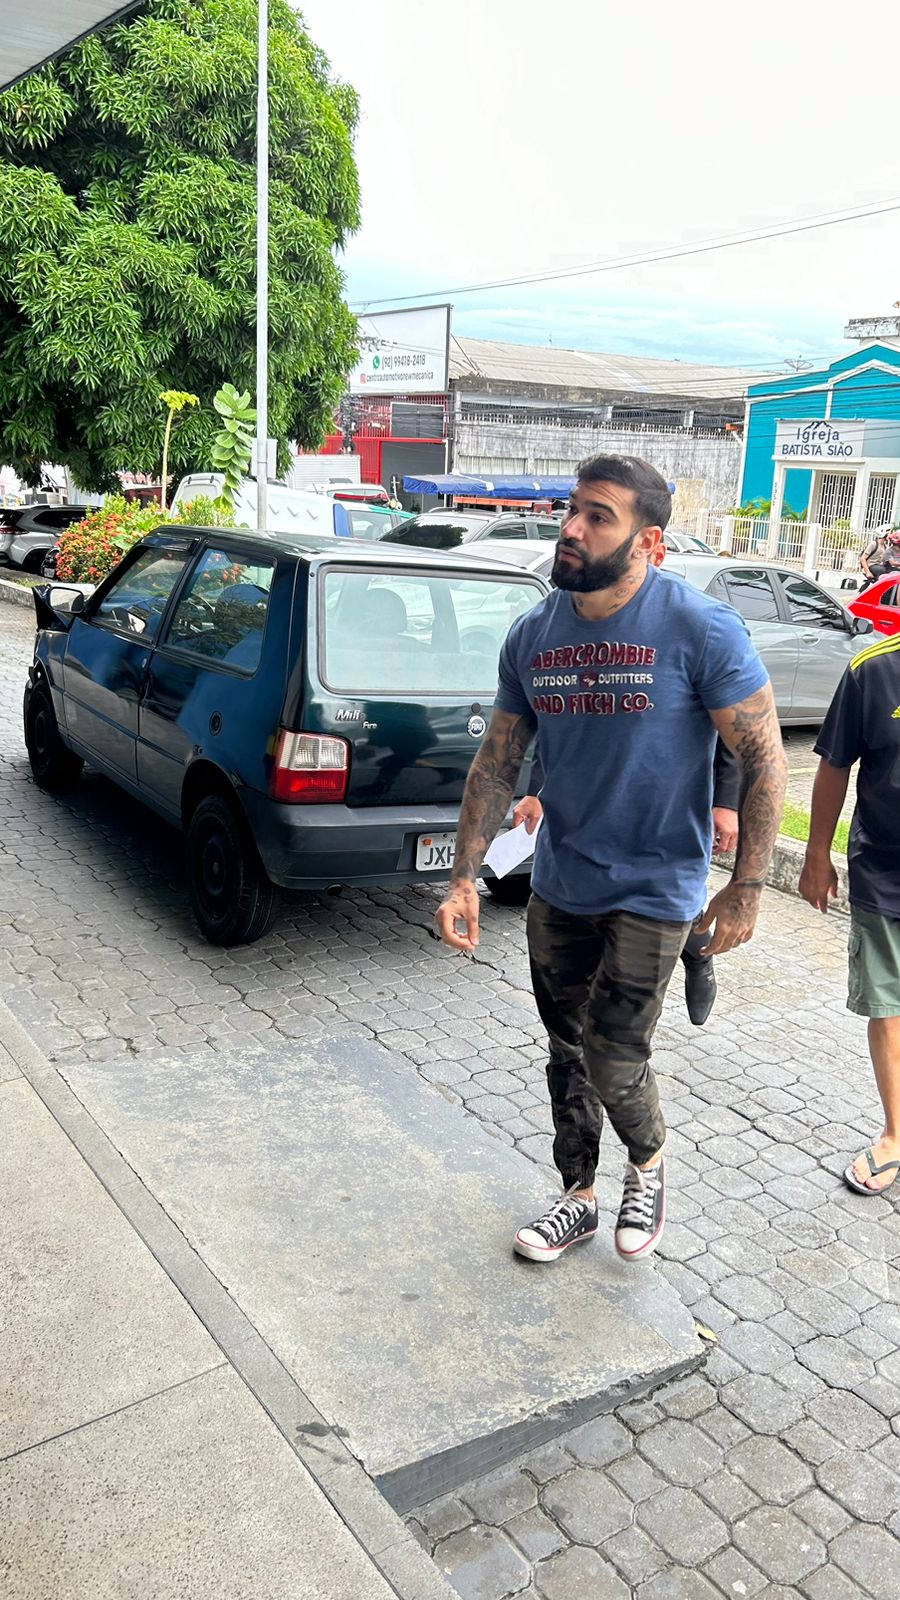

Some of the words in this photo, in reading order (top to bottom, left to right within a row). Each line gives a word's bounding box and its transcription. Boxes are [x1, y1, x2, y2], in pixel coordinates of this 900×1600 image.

[797, 427, 840, 443] Igreja
[782, 444, 822, 455] BATISTA
[827, 441, 853, 456] SIÃO
[530, 641, 656, 670] ABERCROMBIE
[533, 675, 578, 687] OUTDOOR
[598, 673, 654, 684] OUTFITTERS
[533, 693, 565, 714] AND
[568, 692, 616, 715] FITCH
[620, 692, 655, 713] CO.
